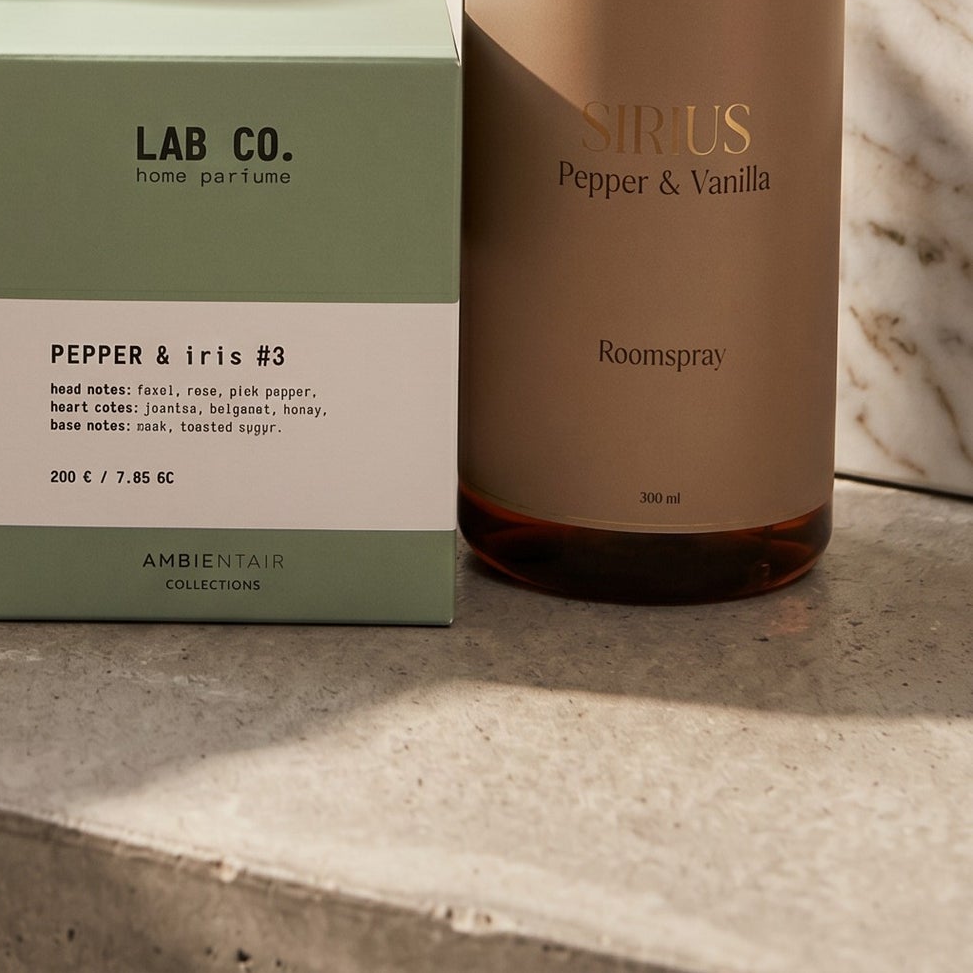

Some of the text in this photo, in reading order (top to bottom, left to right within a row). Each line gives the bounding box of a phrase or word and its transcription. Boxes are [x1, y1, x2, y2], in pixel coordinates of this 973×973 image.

[581, 101, 751, 156] SIRIUS
[137, 126, 292, 161] LAB CO.
[137, 168, 186, 183] home
[560, 161, 770, 199] Pepper & Vanilla
[52, 345, 284, 366] PEPPER & iris #3
[600, 340, 726, 372] Roomspray
[51, 383, 81, 394] head
[88, 384, 130, 395] notes:
[51, 401, 88, 412] heart
[51, 419, 81, 430] base
[87, 420, 130, 431] notes:
[181, 422, 232, 432] toasted
[51, 471, 75, 483] 200
[101, 471, 107, 483] /
[117, 471, 150, 483] 7.85
[640, 492, 680, 504] 300 ml
[143, 554, 283, 568] AMBIENTAIR
[166, 580, 260, 590] COLLECTIONS
